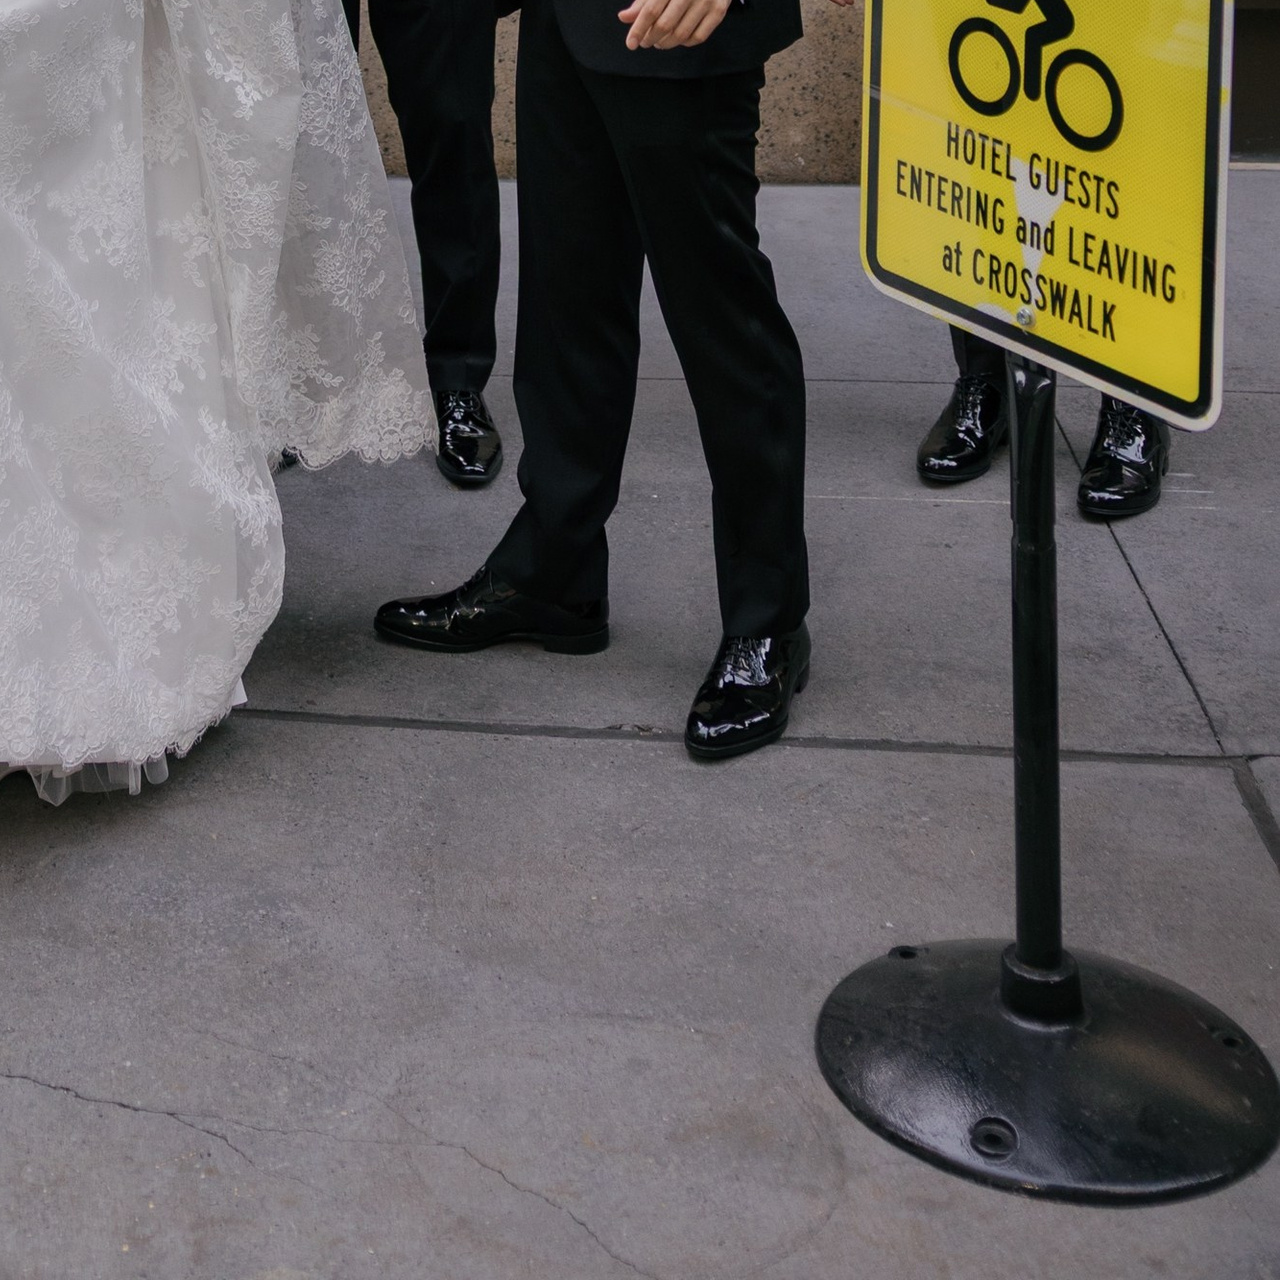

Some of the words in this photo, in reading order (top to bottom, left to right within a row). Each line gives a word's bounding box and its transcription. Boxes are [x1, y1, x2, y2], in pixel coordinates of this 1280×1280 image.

[947, 121, 1017, 182] HOTEL
[1029, 153, 1120, 220] GUESTS
[896, 159, 1005, 235] ENTERING
[1016, 216, 1056, 256] and
[1068, 226, 1176, 303] LEAVING
[942, 241, 963, 277] at
[972, 248, 1117, 343] CROSSWALK
